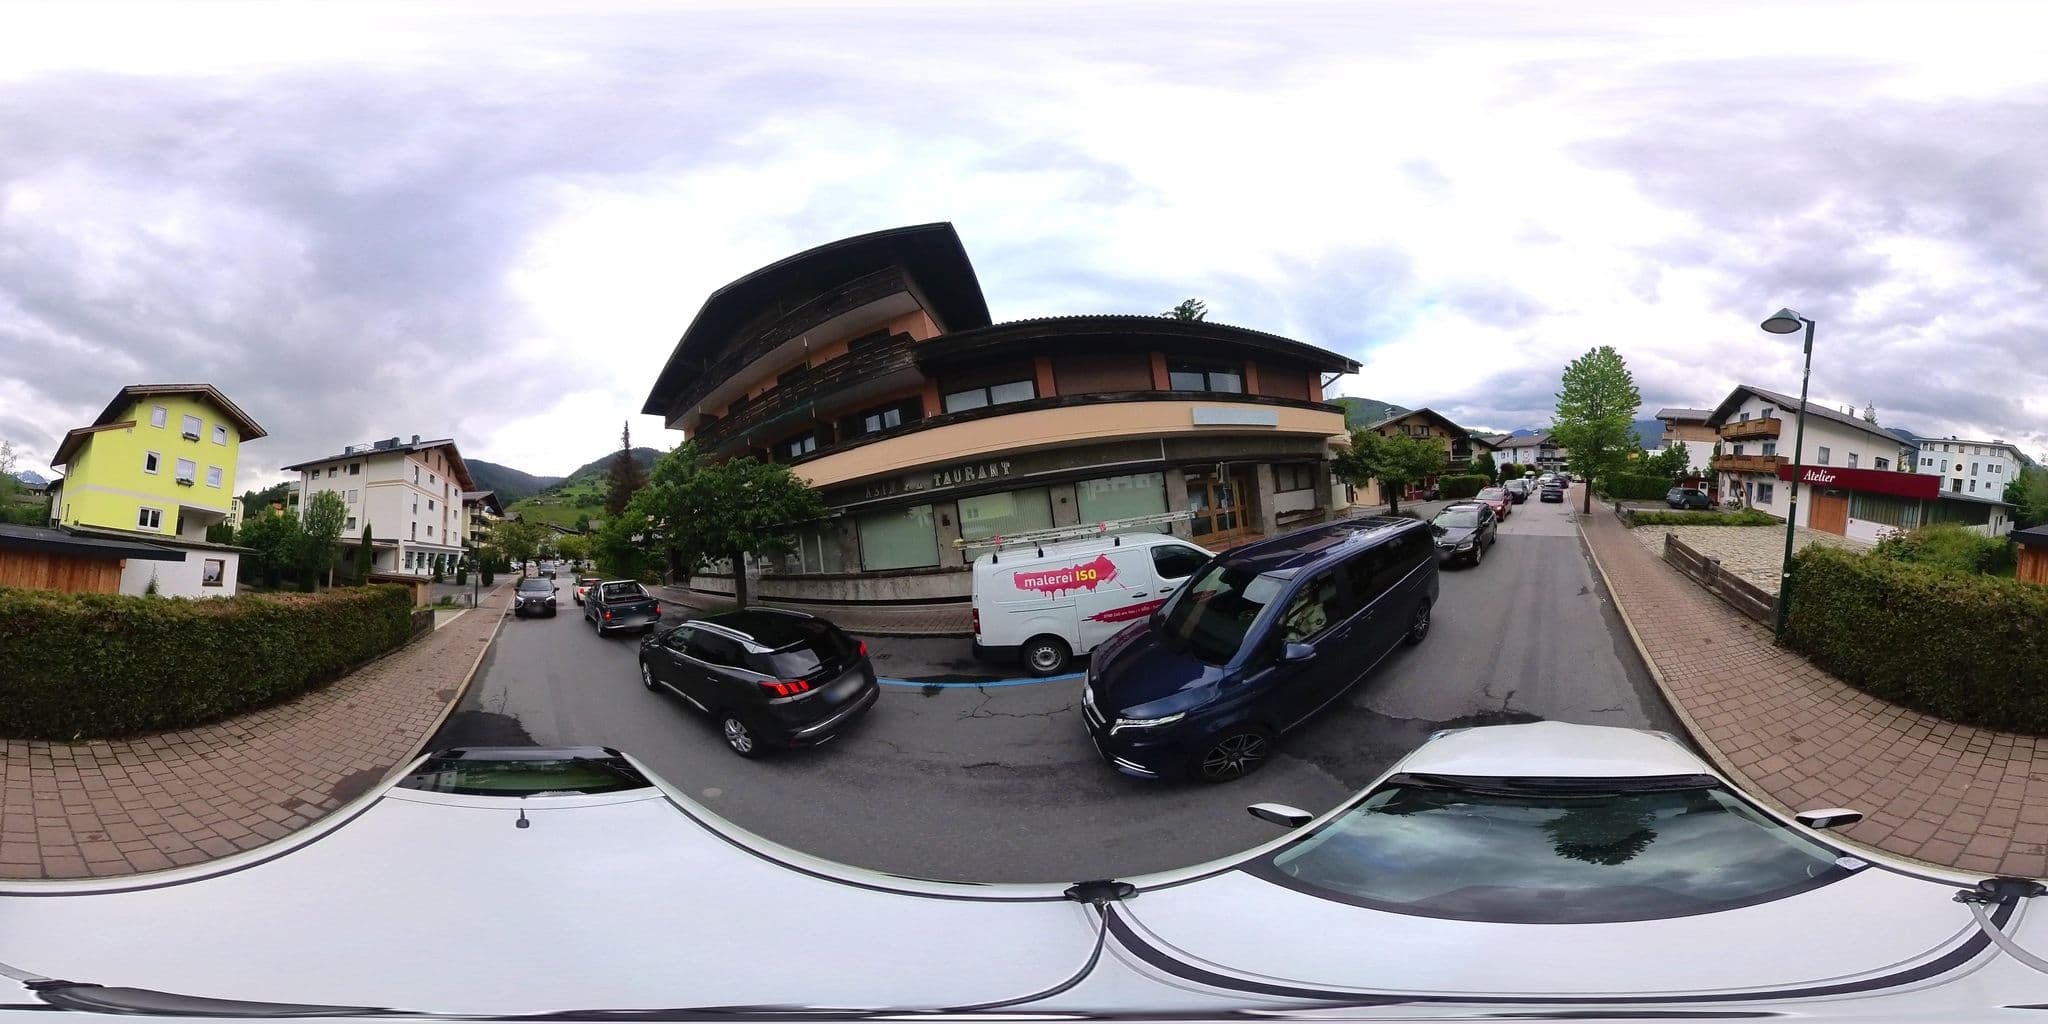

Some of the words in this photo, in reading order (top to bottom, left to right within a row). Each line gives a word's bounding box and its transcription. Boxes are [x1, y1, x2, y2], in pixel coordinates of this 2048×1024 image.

[1803, 469, 1836, 483] Atelier
[1024, 571, 1073, 588] malerei
[1076, 568, 1098, 582] ISO
